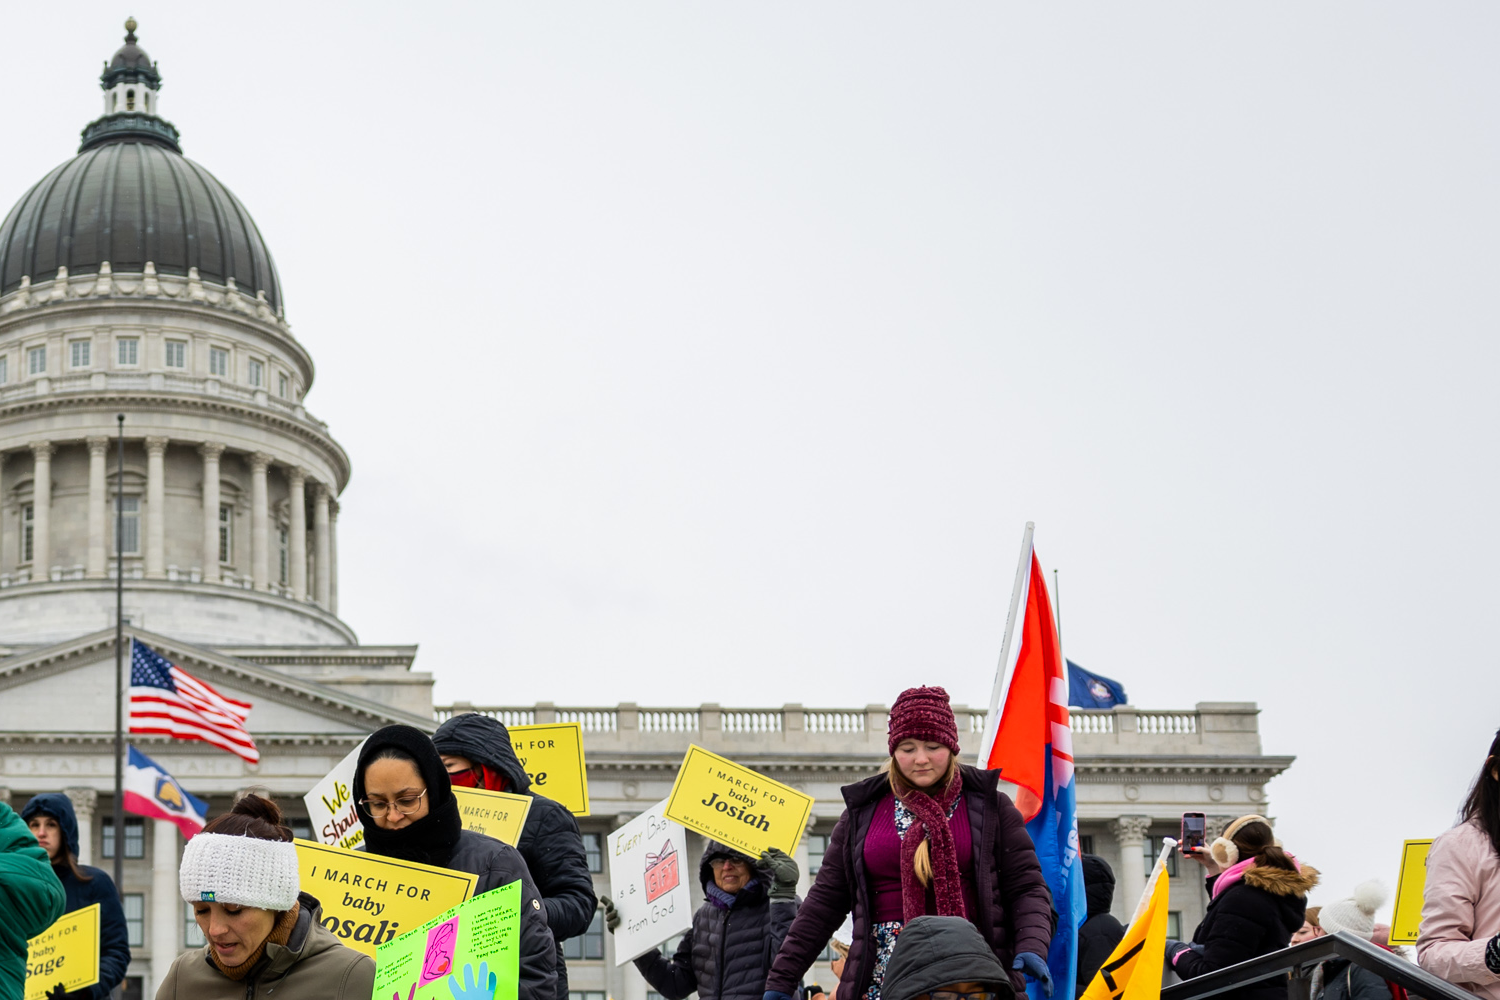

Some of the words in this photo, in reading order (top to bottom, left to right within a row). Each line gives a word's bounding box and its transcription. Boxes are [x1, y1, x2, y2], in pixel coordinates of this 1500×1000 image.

[530, 740, 555, 749] FOR
[174, 760, 216, 773] TAH
[322, 781, 350, 815] We
[717, 771, 758, 794] MARCH
[763, 792, 786, 806] FOR
[728, 788, 756, 808] baby
[322, 804, 359, 846] Shoul
[463, 806, 491, 819] MARCH
[492, 811, 509, 821] FOR
[701, 792, 770, 832] Josiah
[683, 815, 710, 830] MARCH
[713, 828, 728, 838] FOR
[732, 837, 748, 847] LIFE
[311, 866, 317, 877] I
[324, 869, 388, 892] MARCH
[396, 883, 431, 901] FOR
[648, 860, 676, 892] GIFT
[342, 892, 385, 916] baby
[627, 917, 648, 935] from
[652, 895, 674, 924] God
[28, 934, 54, 947] ARCH
[59, 925, 78, 937] FOR
[320, 916, 399, 945] osali
[33, 945, 56, 959] baby
[26, 956, 65, 979] Sage
